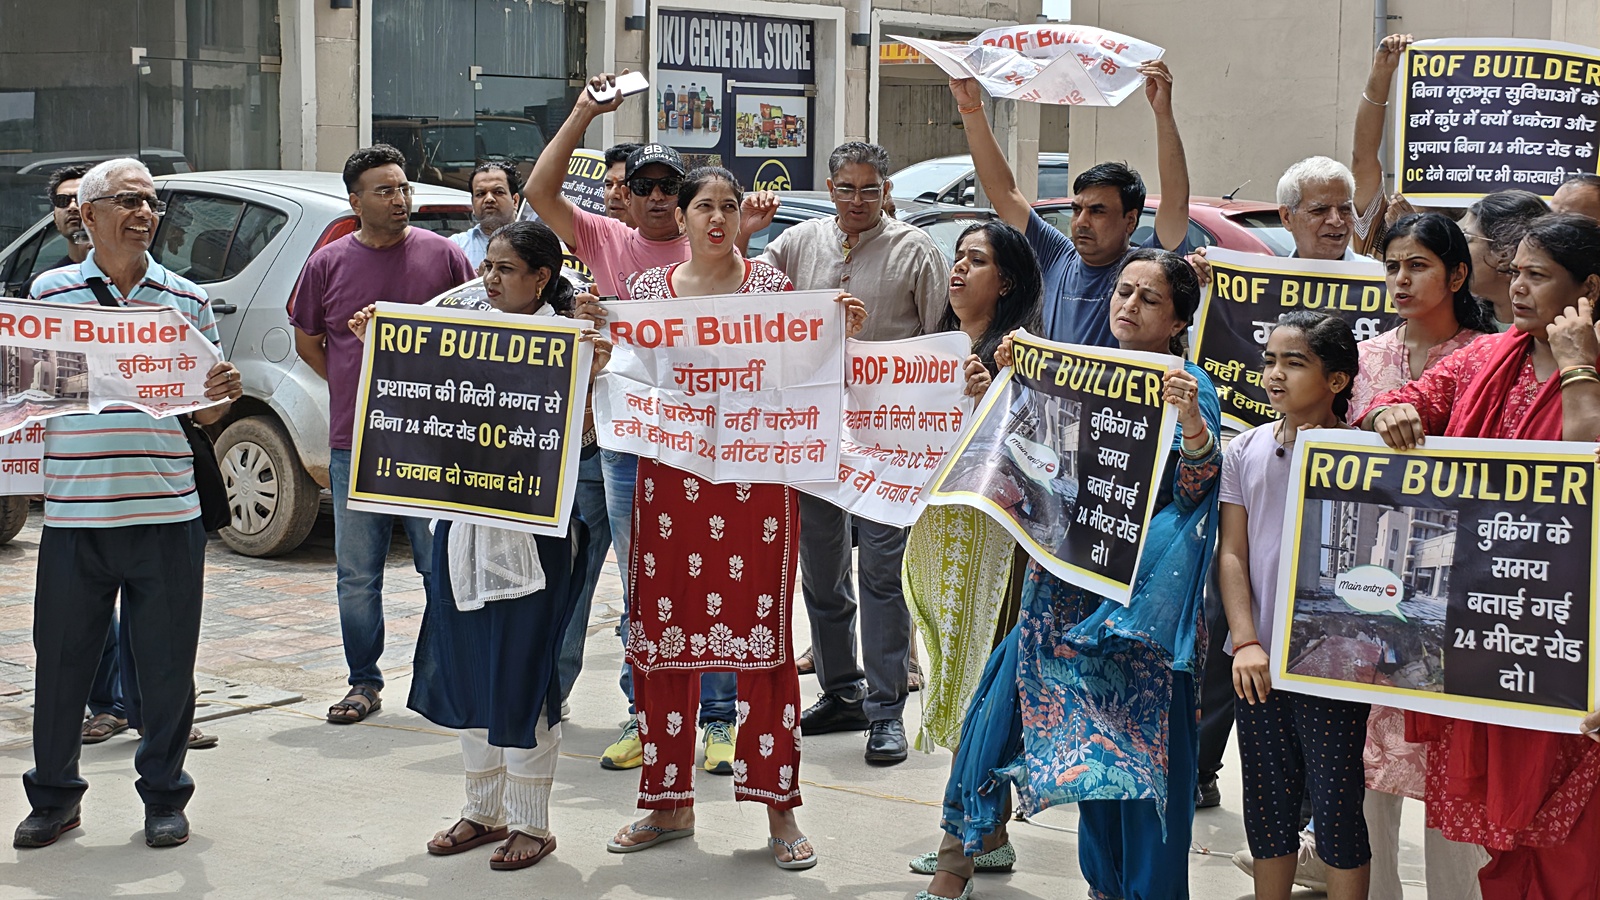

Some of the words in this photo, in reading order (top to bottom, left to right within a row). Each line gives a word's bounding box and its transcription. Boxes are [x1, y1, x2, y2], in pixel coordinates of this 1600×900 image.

[689, 17, 762, 69] GENERAL
[764, 22, 811, 70] STORE
[1412, 54, 1465, 77] ROF
[1473, 55, 1600, 86] BUILDER
[1412, 81, 1444, 98] बिना
[1447, 85, 1502, 104] मूलभूत
[1505, 83, 1580, 105] सुविधाओं
[1581, 90, 1600, 106] के
[1410, 109, 1433, 128] हमें
[1463, 109, 1480, 126] में
[1480, 109, 1512, 126] क्यों
[1513, 111, 1562, 129] धकेला
[1565, 114, 1597, 132] और
[1408, 141, 1451, 160] चुपचाप
[1454, 136, 1485, 153] बिना
[1488, 141, 1503, 154] 24
[1507, 137, 1544, 155] मीटर
[1546, 139, 1572, 157] रोड
[1575, 142, 1594, 158] के
[1406, 168, 1423, 182] OC
[1426, 165, 1445, 182] देने
[1446, 165, 1475, 182] वालों
[1476, 168, 1493, 181] पर
[1494, 164, 1512, 183] भी
[1513, 166, 1565, 185] कारवाही
[443, 297, 461, 306] OC
[1216, 272, 1269, 304] ROF
[1280, 279, 1399, 314] BUILDE
[74, 319, 190, 344] Builder
[380, 323, 432, 354] ROF
[439, 329, 567, 368] BUILDER
[610, 318, 683, 349] ROF
[696, 313, 824, 346] Builder
[116, 354, 173, 379] बुकिंग
[176, 353, 197, 371] के
[673, 359, 767, 397] गुंडागर्दी
[852, 356, 888, 385] ROF
[892, 355, 958, 385] Builder
[1014, 344, 1054, 381] ROF
[1054, 356, 1160, 408] BUILDER
[1204, 357, 1245, 382] नहीं
[136, 383, 185, 398] समय
[377, 378, 432, 400] प्रशासन
[435, 379, 455, 404] की
[459, 381, 496, 407] मिली
[499, 391, 540, 412] भगत
[544, 390, 562, 414] से
[369, 410, 403, 432] बिना
[405, 418, 420, 434] 24
[423, 415, 454, 438] मीटर
[456, 419, 476, 442] रोड
[479, 422, 507, 448] OC
[508, 425, 536, 450] कैसे
[539, 429, 560, 451] ली
[663, 402, 716, 429] चलेगी
[724, 406, 762, 432] नहीं
[764, 405, 820, 430] चलेगी
[874, 404, 887, 430] की
[889, 404, 915, 431] मिली
[918, 411, 947, 432] भगत
[949, 406, 963, 432] से
[1091, 407, 1132, 440] बुकिंग
[1132, 416, 1149, 440] के
[2, 458, 41, 474] जवाब
[698, 438, 716, 463] 24
[721, 438, 770, 463] मीटर
[774, 438, 802, 464] रोड
[807, 438, 827, 463] दो
[1009, 437, 1028, 459] Main
[1027, 453, 1045, 469] entry
[1097, 447, 1130, 471] समय
[376, 457, 391, 477] !!
[396, 462, 443, 483] जवाब
[445, 463, 461, 486] दो
[464, 471, 504, 492] जवाब
[507, 471, 524, 494] दो
[528, 476, 541, 497] !!
[853, 470, 876, 493] दो
[876, 481, 912, 503] जवाब
[1087, 475, 1115, 503] बताई
[1115, 481, 1140, 509] गई
[1309, 452, 1390, 491] ROF
[1401, 459, 1587, 505] BUILDER
[1076, 506, 1088, 525] 24
[1089, 508, 1116, 536] मीटर
[1116, 516, 1140, 543] रोड
[1477, 512, 1541, 551] बुकिंग
[1546, 517, 1572, 545] के
[1491, 557, 1549, 581] समय
[1338, 579, 1362, 592] Main
[1363, 583, 1385, 597] entry
[1467, 588, 1525, 621] बताई
[1531, 592, 1572, 625] गई
[1454, 628, 1476, 649] 24
[1483, 625, 1540, 656] मीटर
[1544, 631, 1583, 663] रोड
